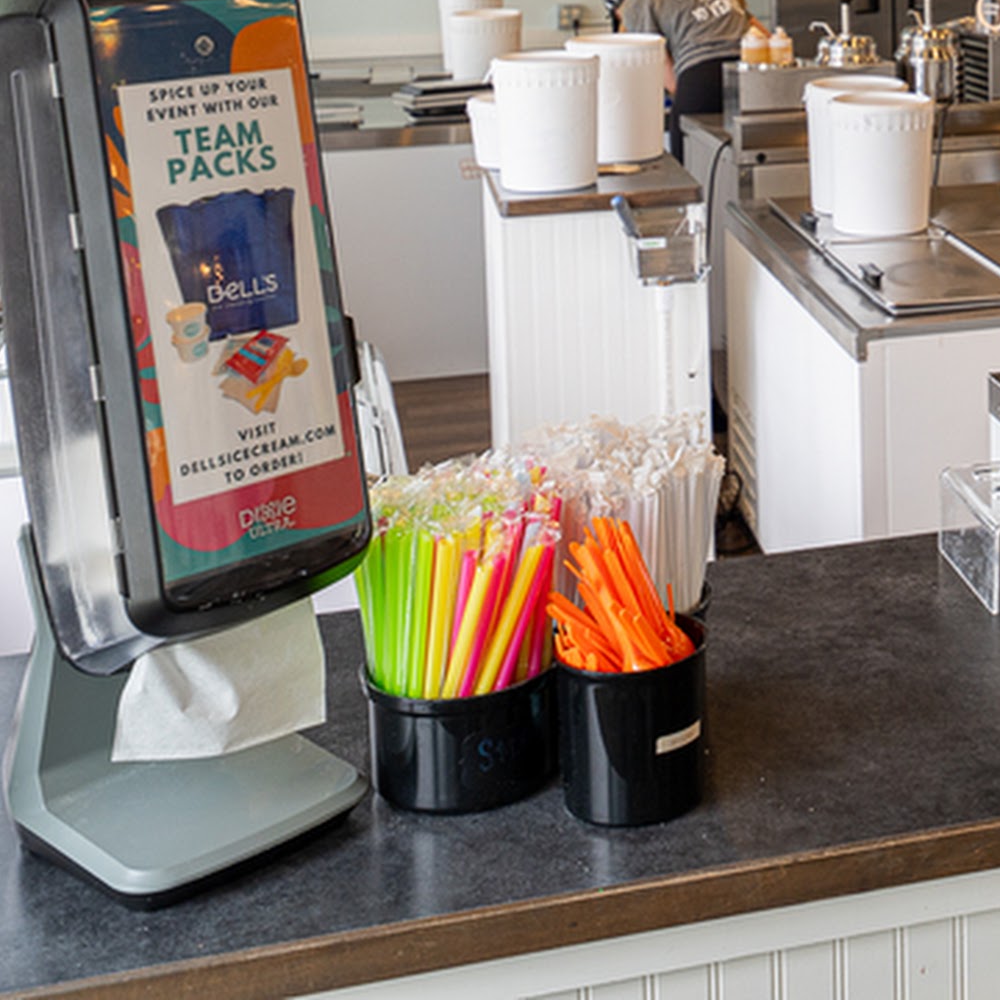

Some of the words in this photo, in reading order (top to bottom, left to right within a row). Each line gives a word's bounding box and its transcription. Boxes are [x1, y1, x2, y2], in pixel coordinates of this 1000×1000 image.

[149, 85, 195, 103] SPICE
[199, 82, 220, 97] UP
[225, 77, 267, 93] YOUR
[146, 103, 197, 122] EVENT
[202, 99, 244, 115] WITH
[247, 94, 279, 110] OUR
[173, 119, 263, 155] TEAM
[167, 144, 277, 185] PACKS
[237, 421, 277, 441] VISIT
[179, 424, 336, 477] DELLSICECREAM.COM
[224, 467, 246, 484] TO
[249, 451, 304, 477] ORDER!
